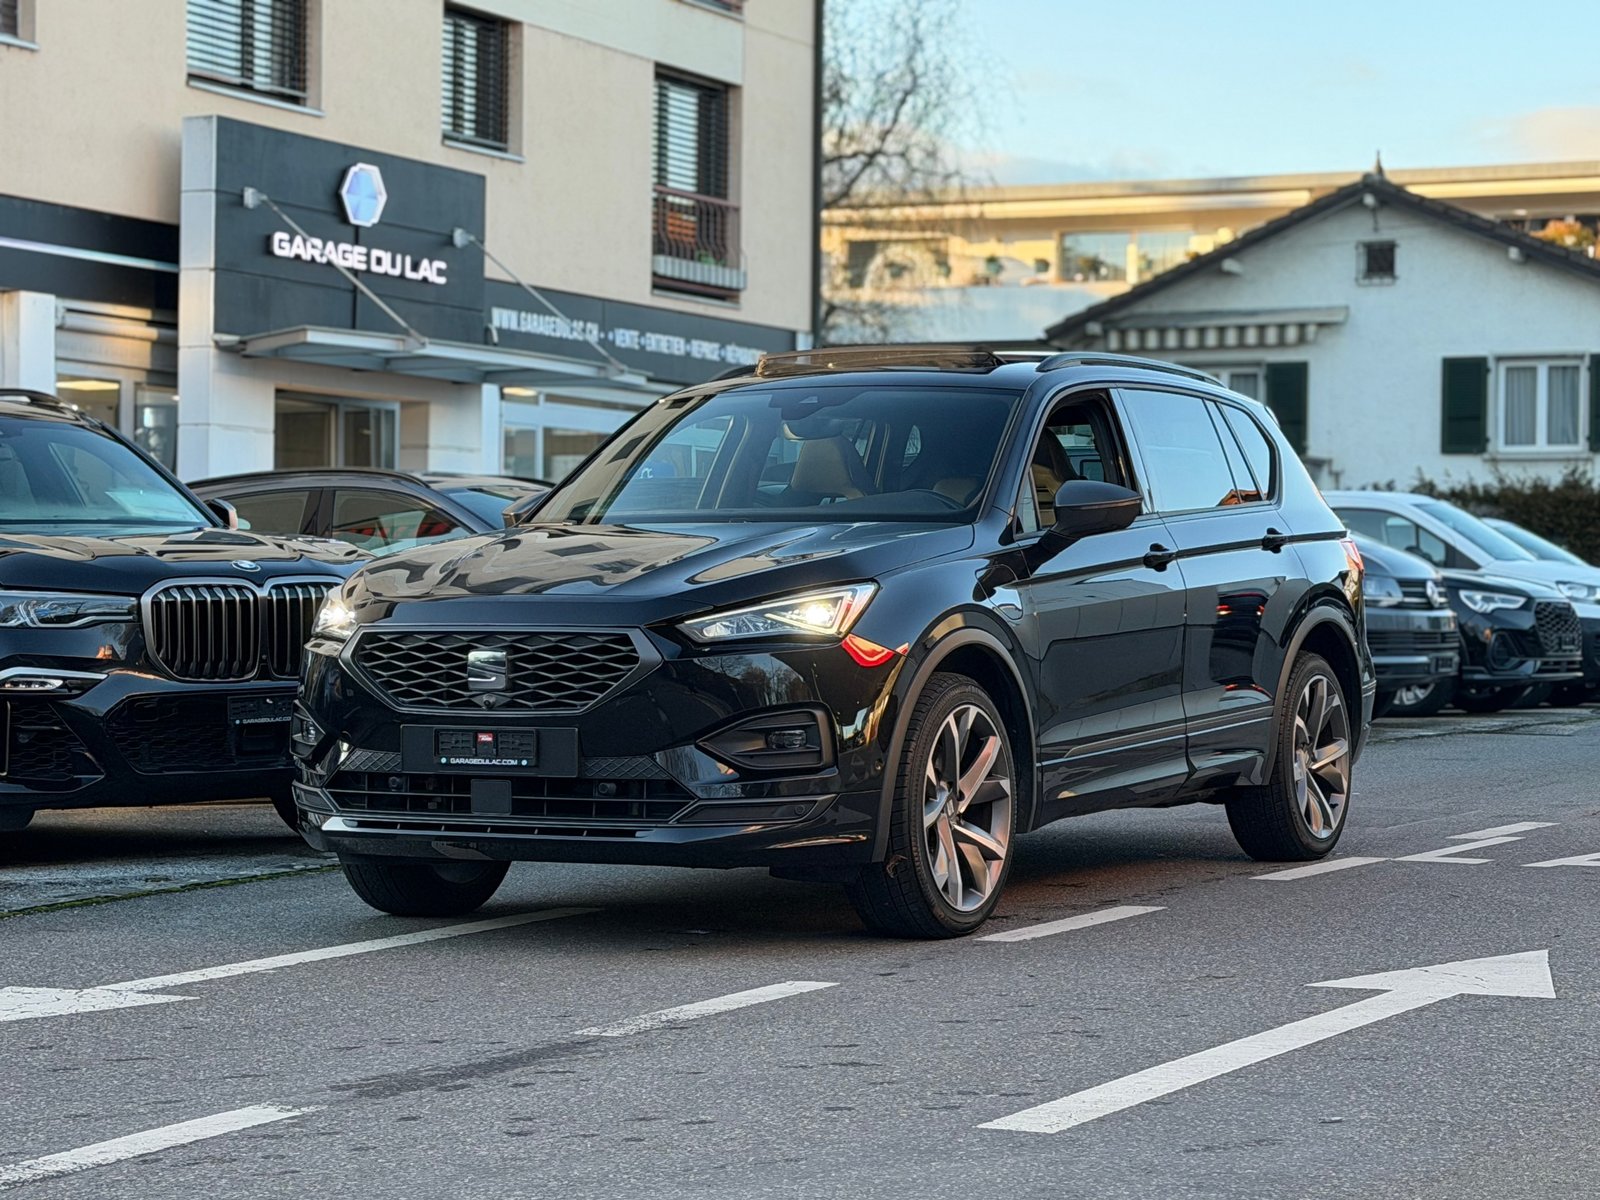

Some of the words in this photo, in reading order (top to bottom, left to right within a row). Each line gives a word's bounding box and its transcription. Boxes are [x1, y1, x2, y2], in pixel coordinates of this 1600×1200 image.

[272, 231, 367, 271] GARAGE
[370, 248, 402, 277] DU
[404, 255, 448, 285] LAC
[242, 716, 292, 724] GARAGEDULAC.CO
[450, 757, 518, 765] GARAGEDULAC.COM
